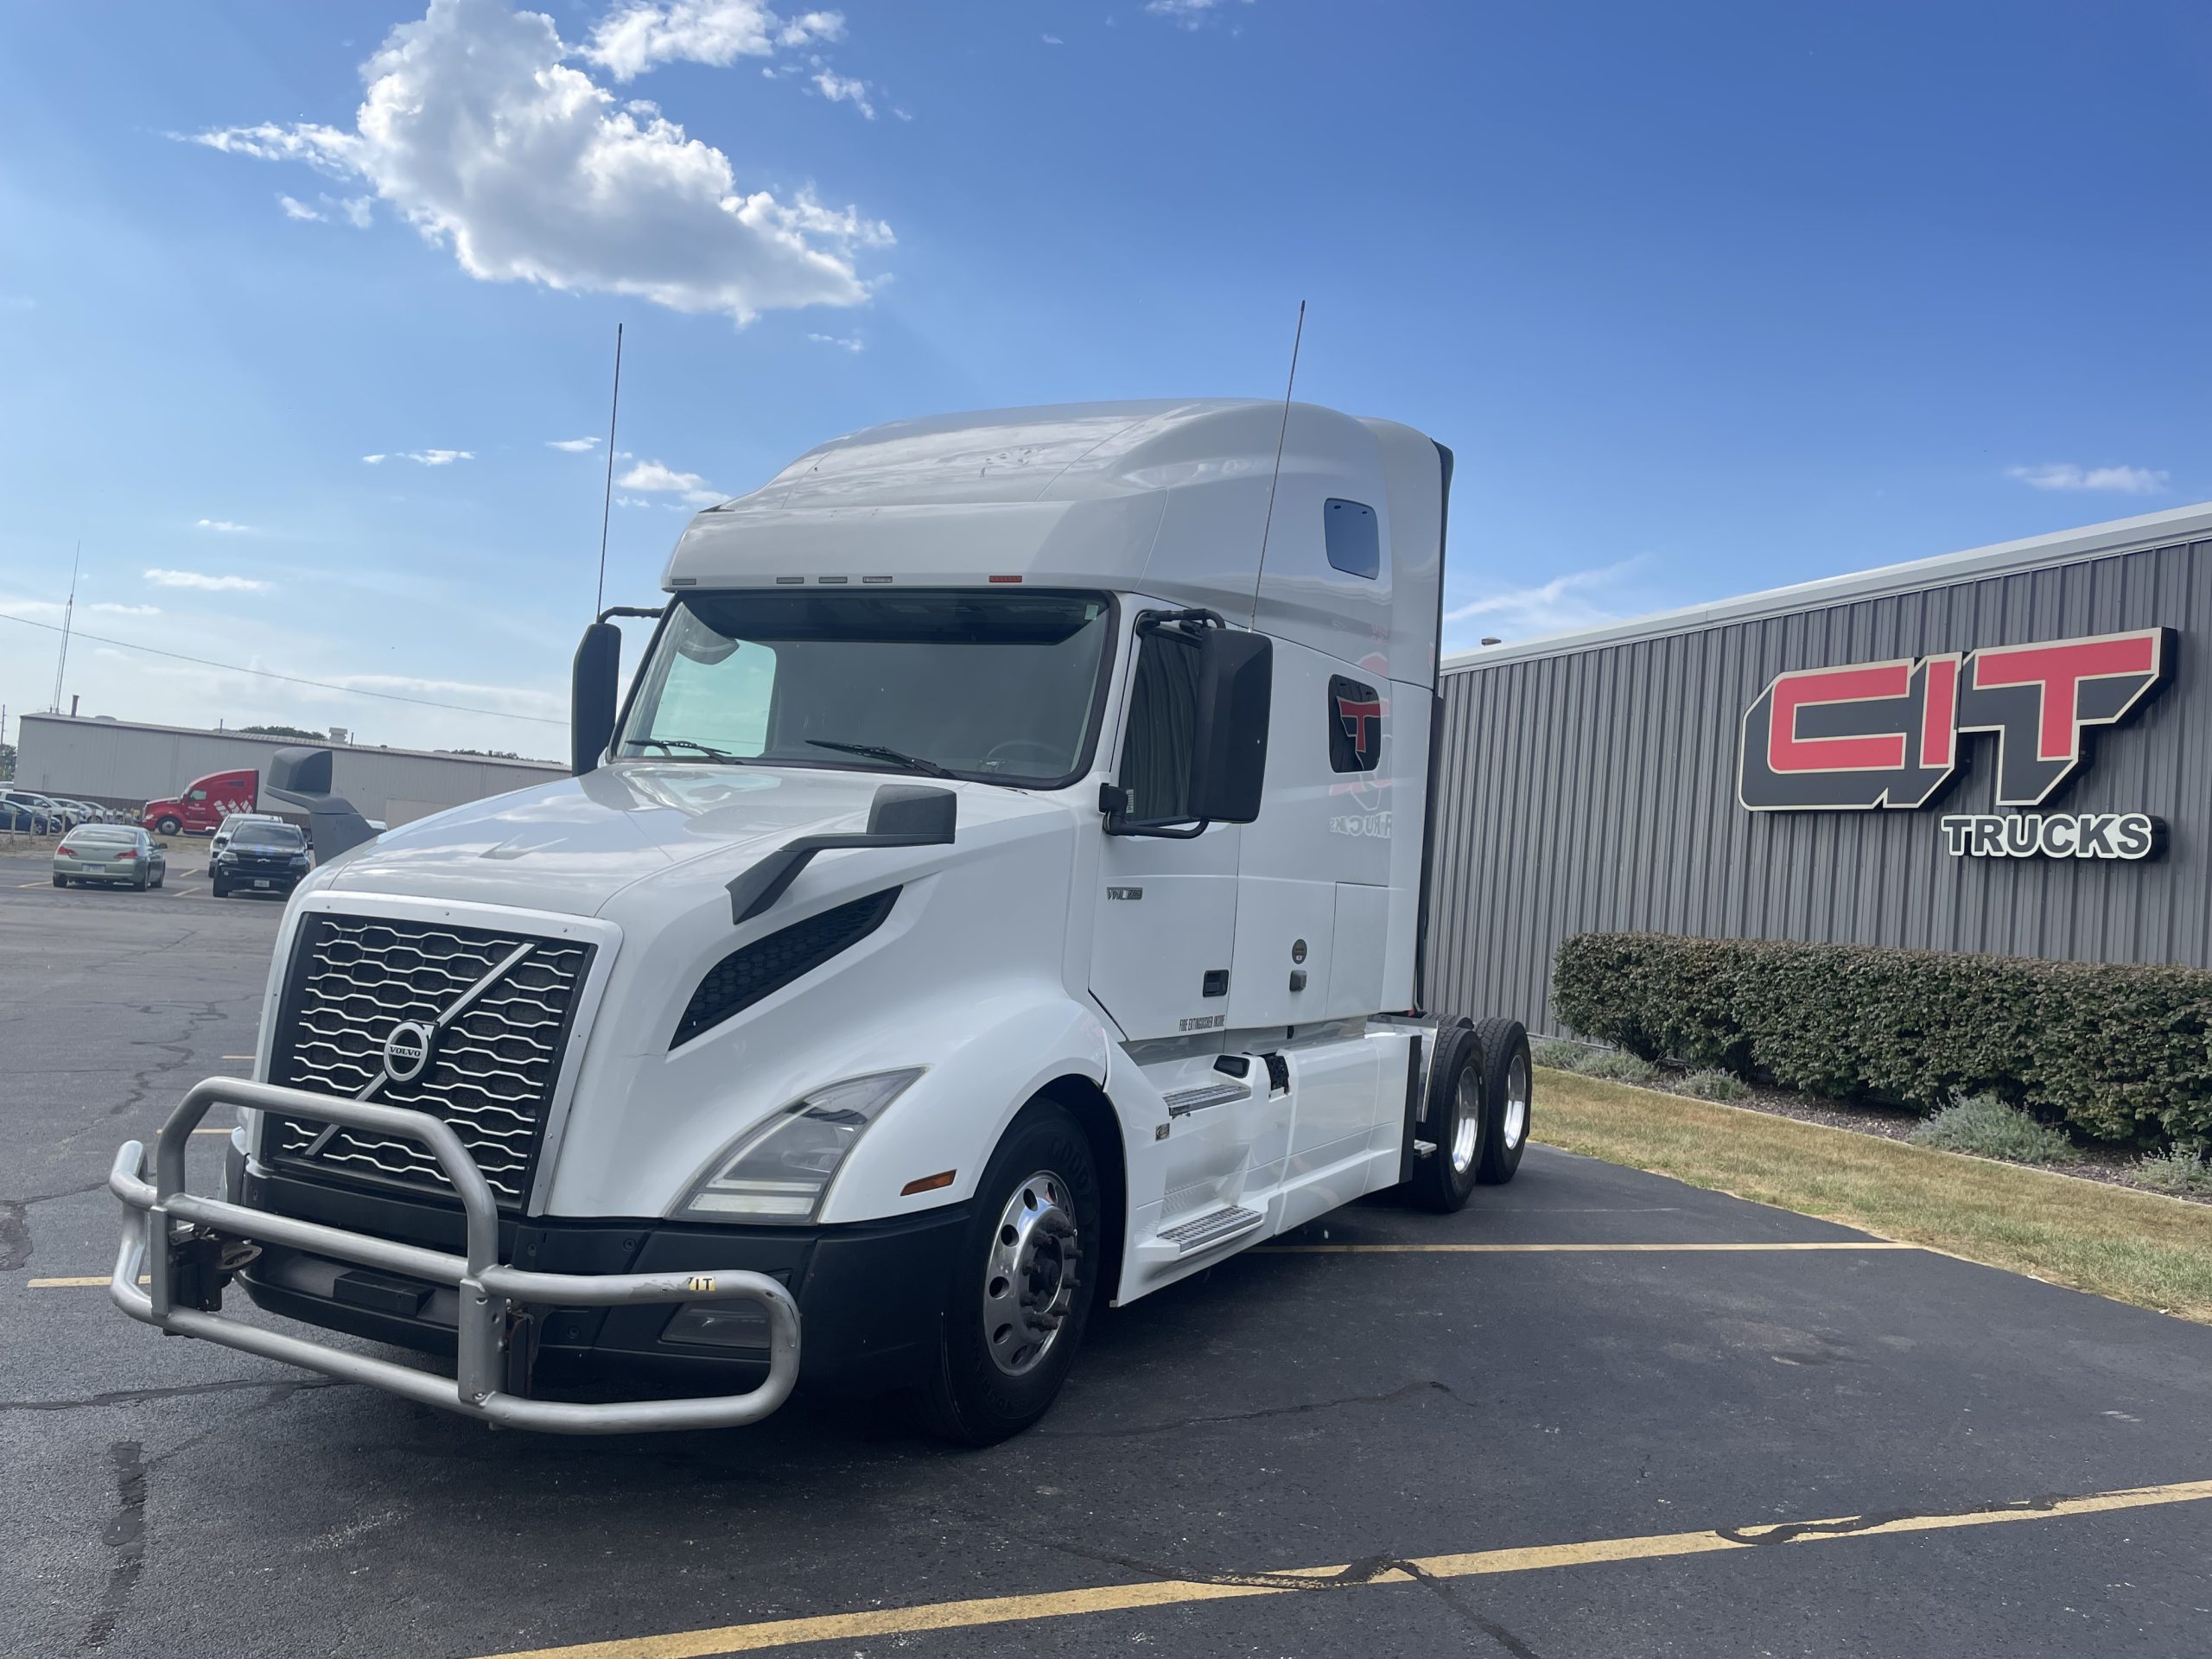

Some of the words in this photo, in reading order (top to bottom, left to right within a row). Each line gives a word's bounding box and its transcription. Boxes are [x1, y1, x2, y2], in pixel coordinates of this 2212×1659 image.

[1764, 628, 2162, 774] CIT
[1941, 814, 2152, 858] TRUCKS
[390, 1046, 421, 1058] VOLVO
